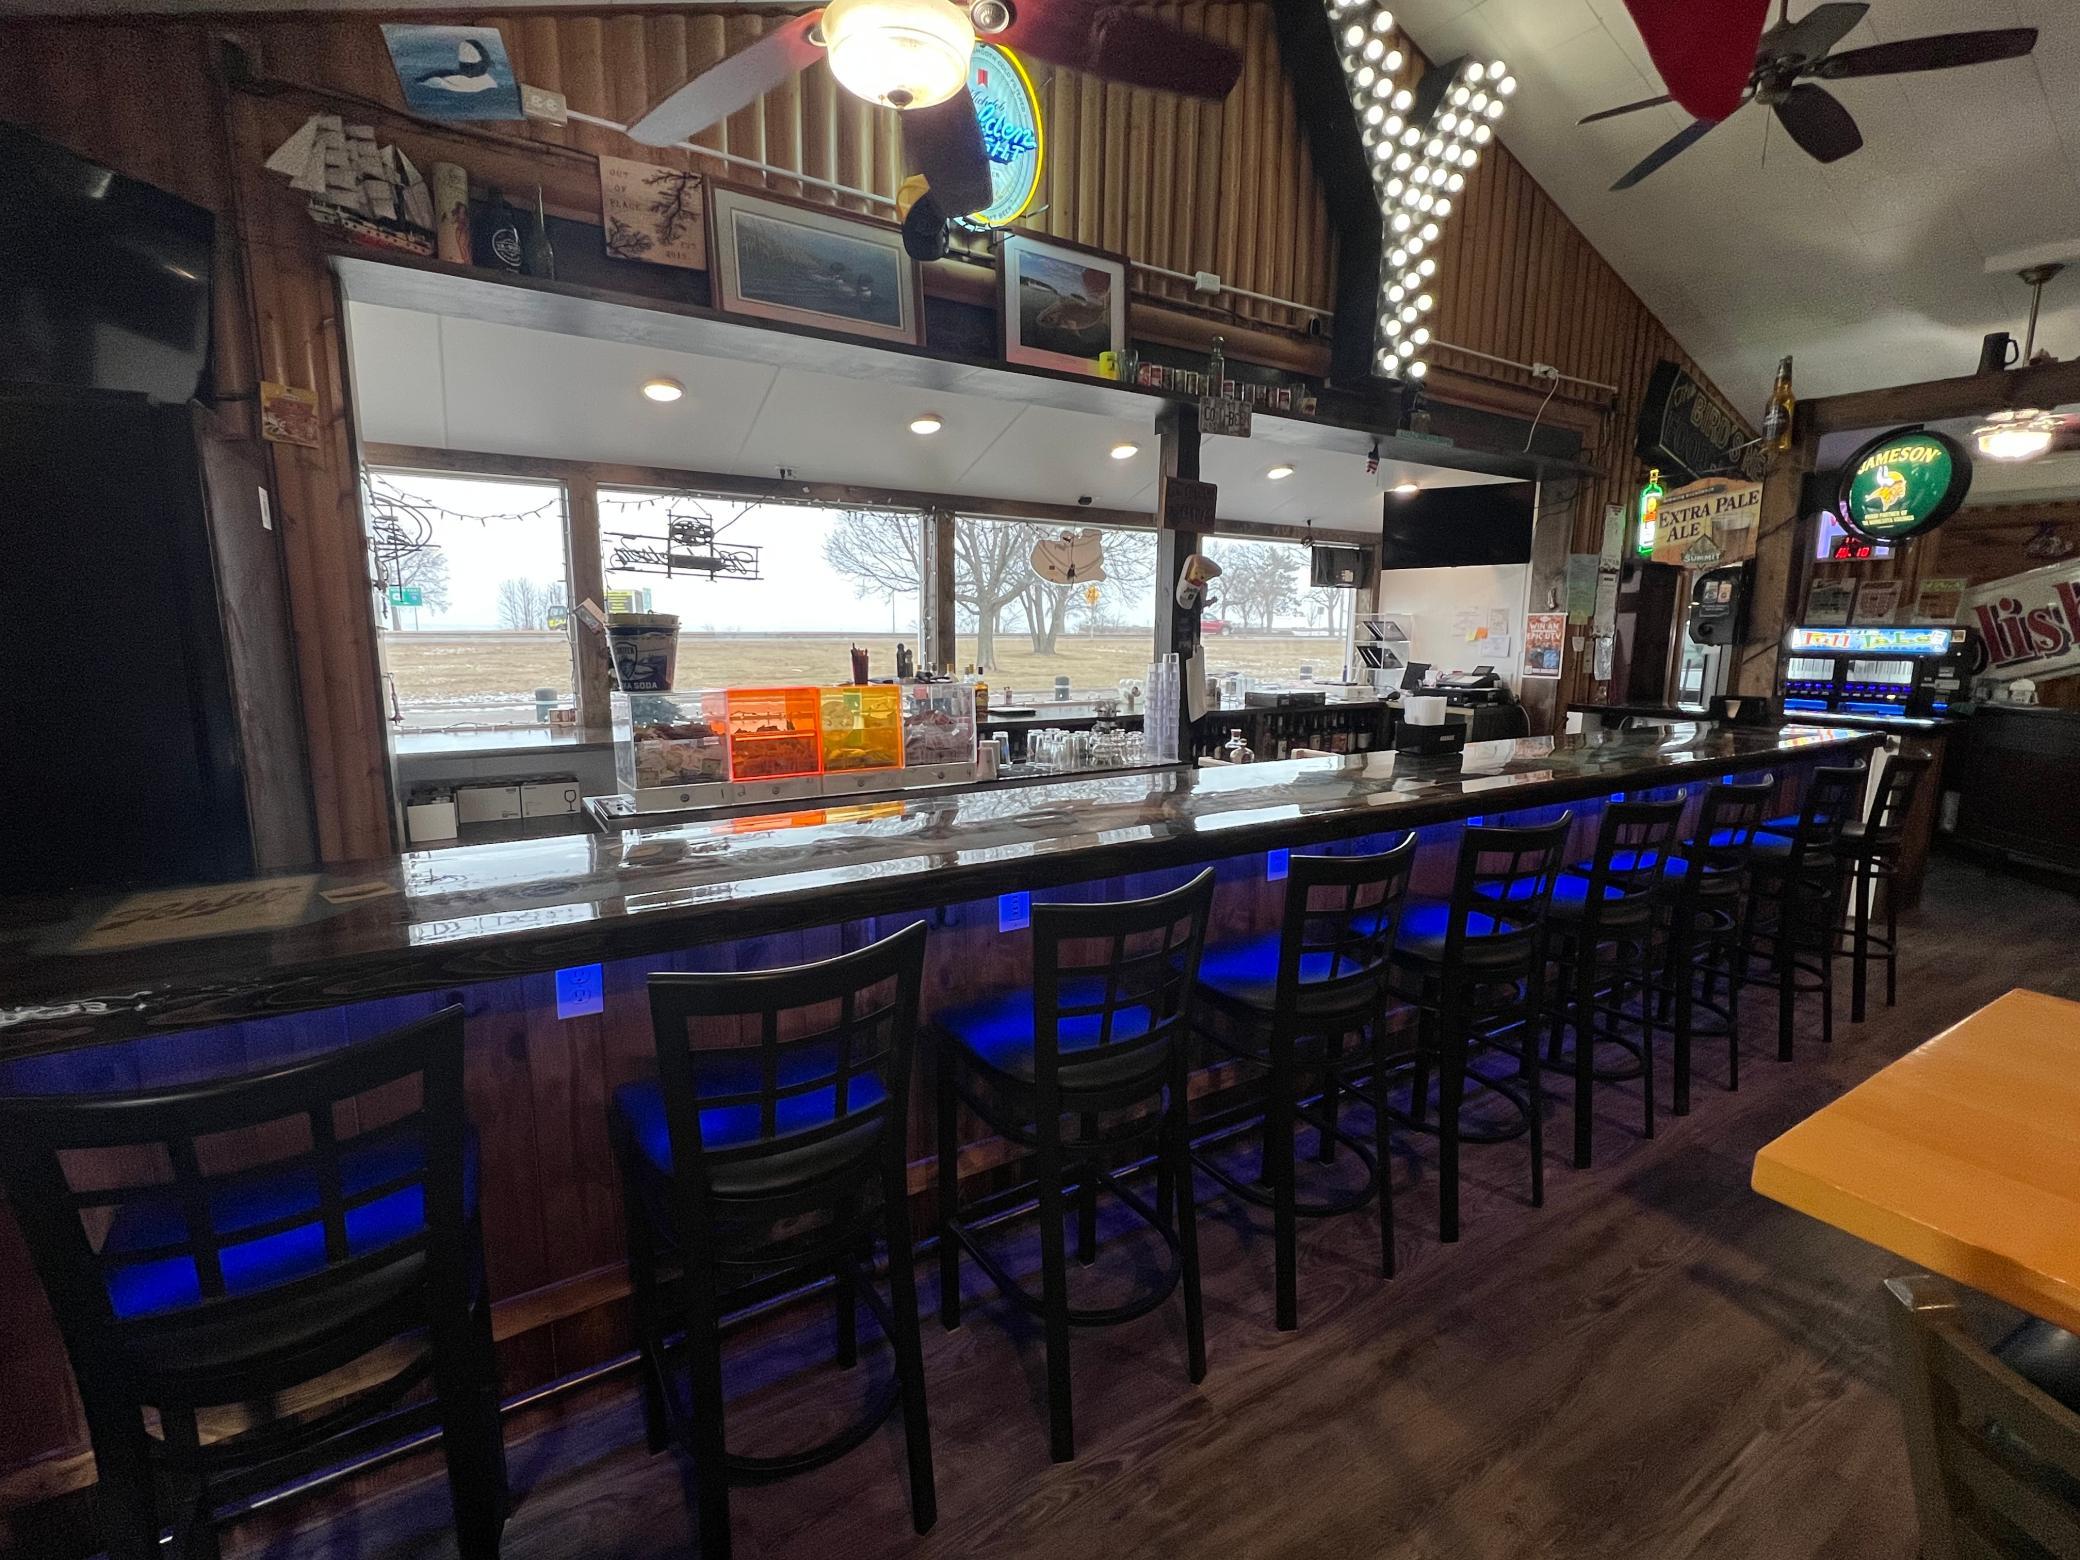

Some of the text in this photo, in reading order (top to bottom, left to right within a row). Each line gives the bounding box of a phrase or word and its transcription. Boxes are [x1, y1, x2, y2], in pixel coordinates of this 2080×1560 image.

[978, 104, 1037, 148] lden
[609, 198, 641, 211] PLACE
[1857, 446, 1941, 475] JAMESON
[1658, 503, 1710, 529] EXTRA
[1715, 490, 1760, 513] PALE
[1667, 522, 1701, 543] ALE
[1684, 553, 1720, 563] SUMMIT
[633, 681, 659, 690] SODA
